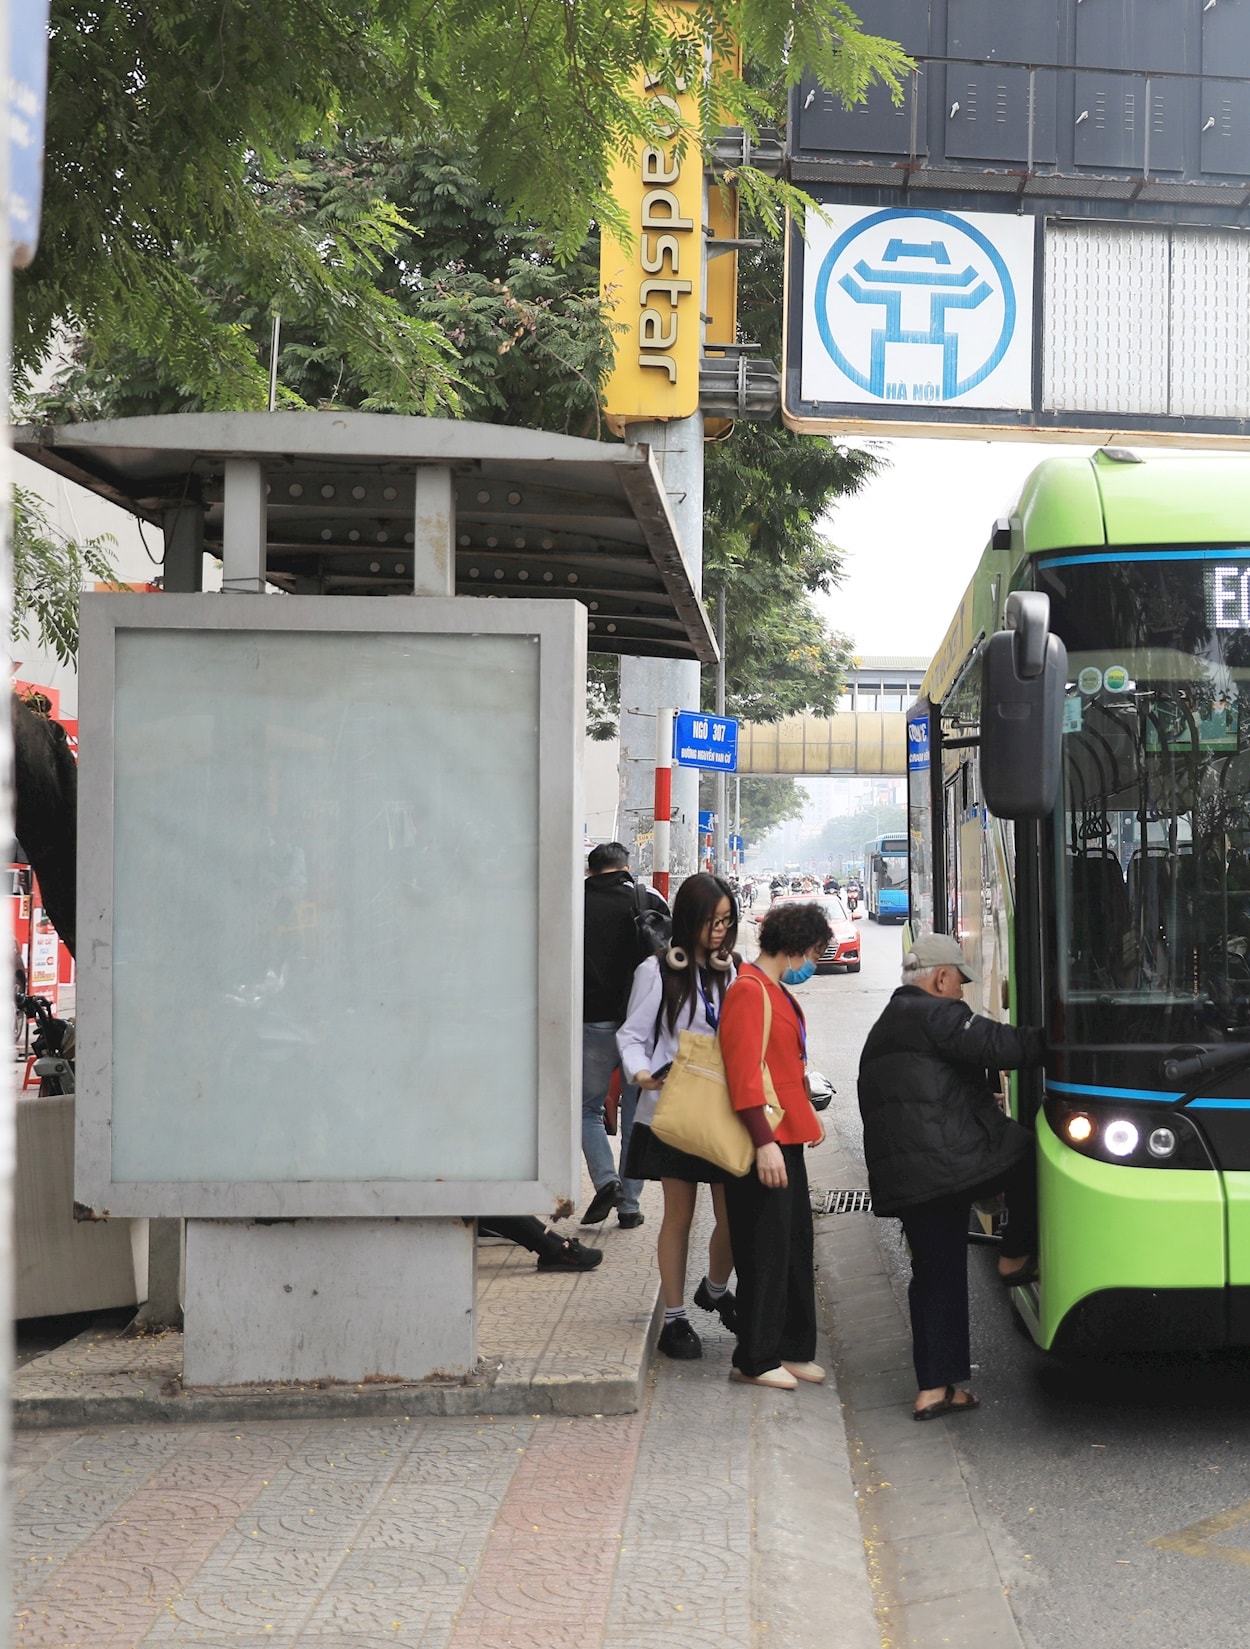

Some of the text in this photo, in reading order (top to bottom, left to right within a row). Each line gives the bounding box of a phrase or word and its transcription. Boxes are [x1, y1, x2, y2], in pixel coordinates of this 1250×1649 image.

[886, 380, 941, 404] HÀ NỘI
[692, 719, 726, 742] NGÕ 307
